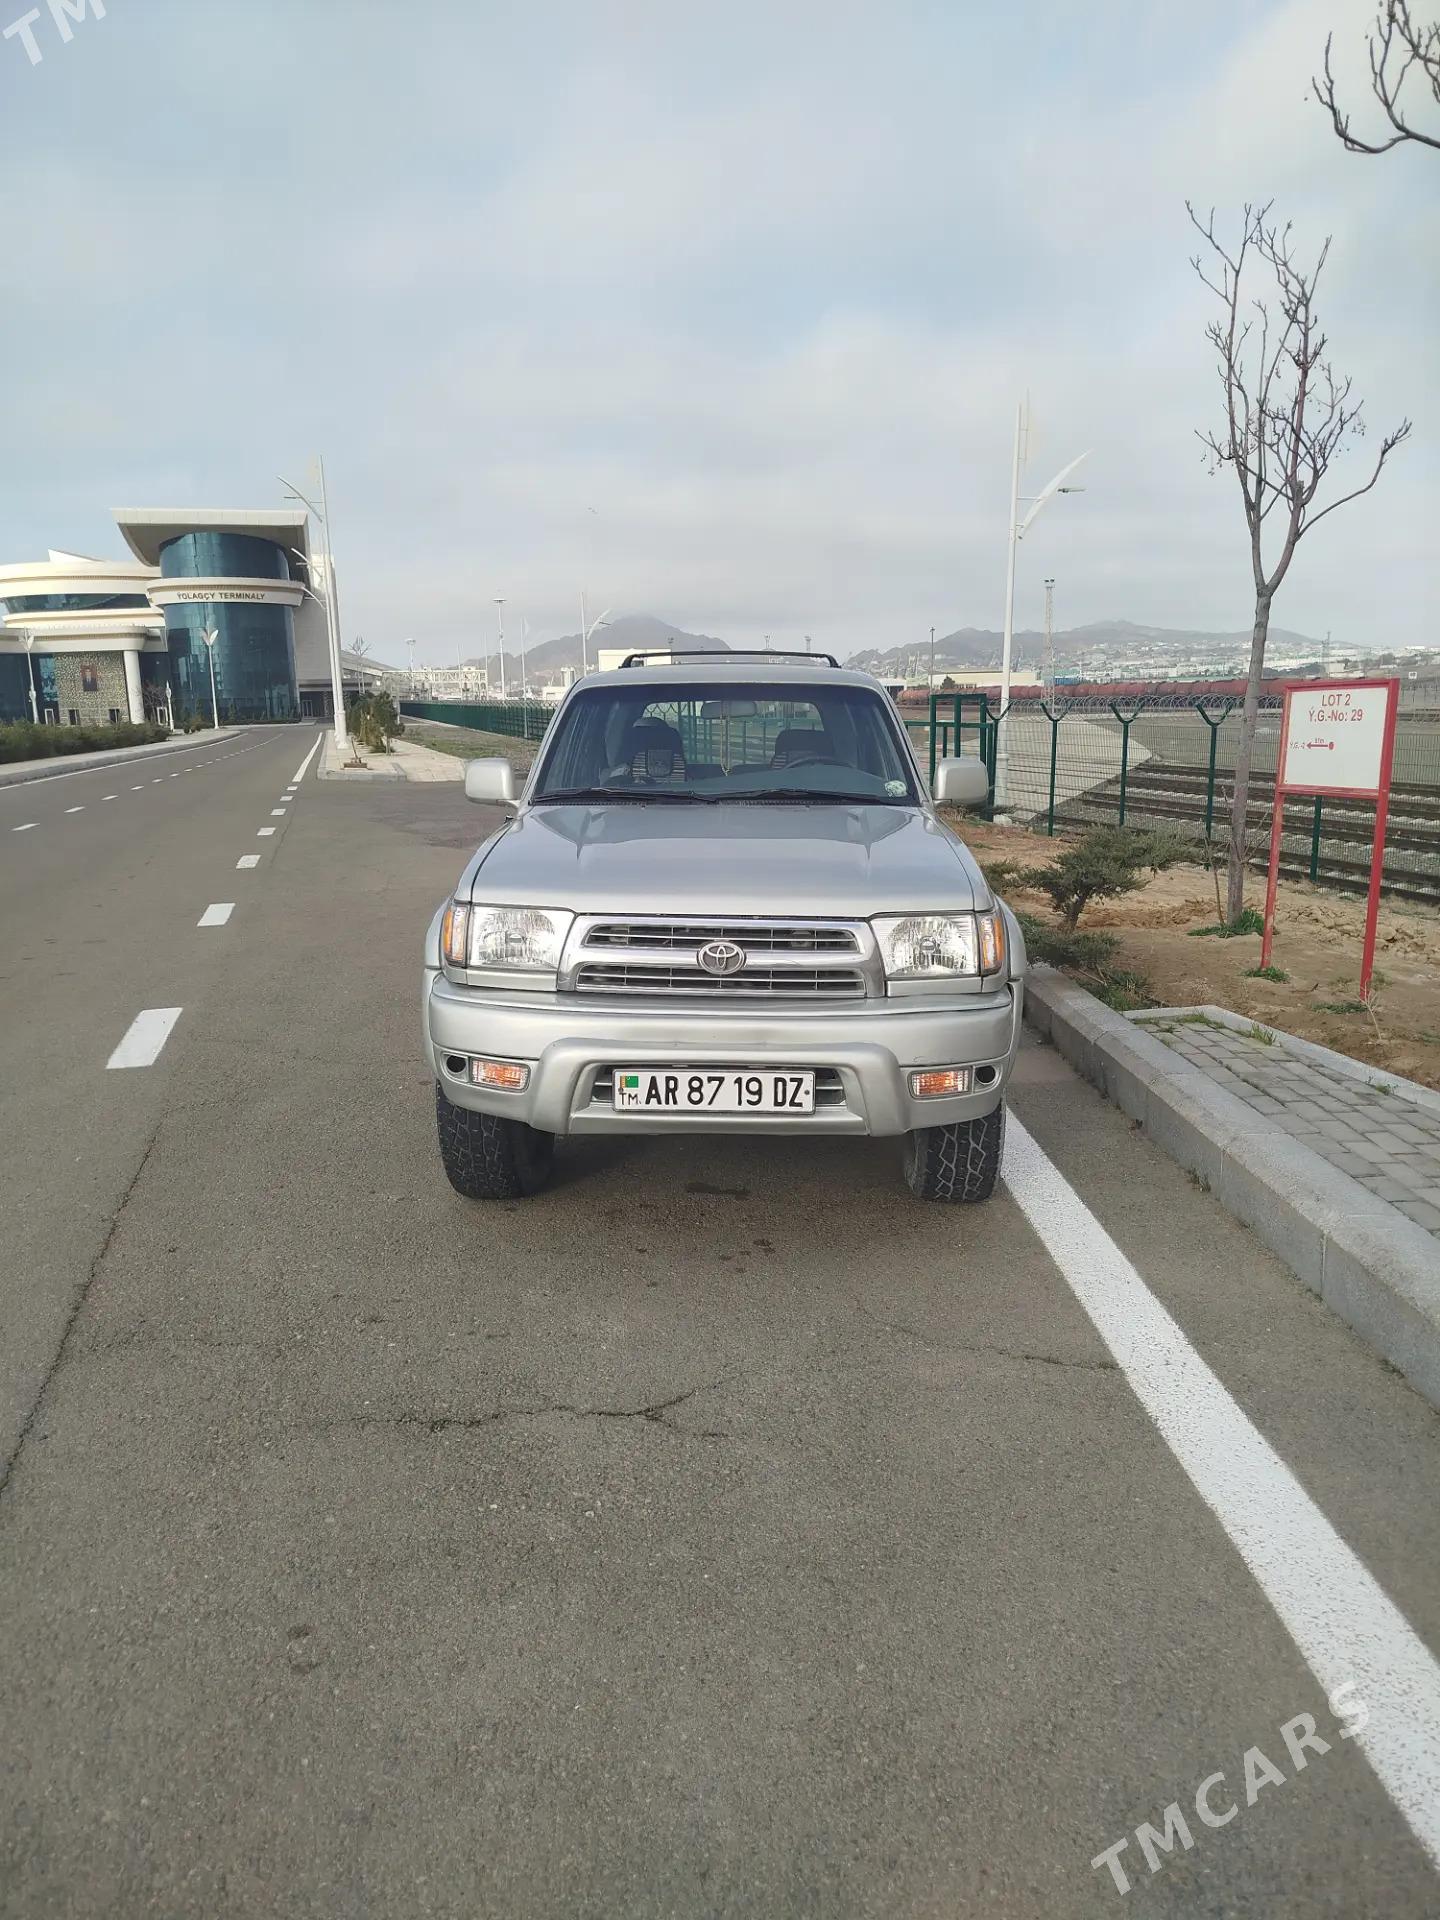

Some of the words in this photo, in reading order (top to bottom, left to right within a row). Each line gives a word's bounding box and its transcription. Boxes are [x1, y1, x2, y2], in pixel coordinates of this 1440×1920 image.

[219, 592, 265, 600] TERMINALY
[1322, 694, 1342, 706] LOT
[1345, 694, 1351, 706] 2
[1350, 709, 1363, 721] 29
[645, 1076, 679, 1105] AR
[687, 1076, 725, 1105] 87
[734, 1077, 763, 1106] 19
[773, 1077, 803, 1107] DZ
